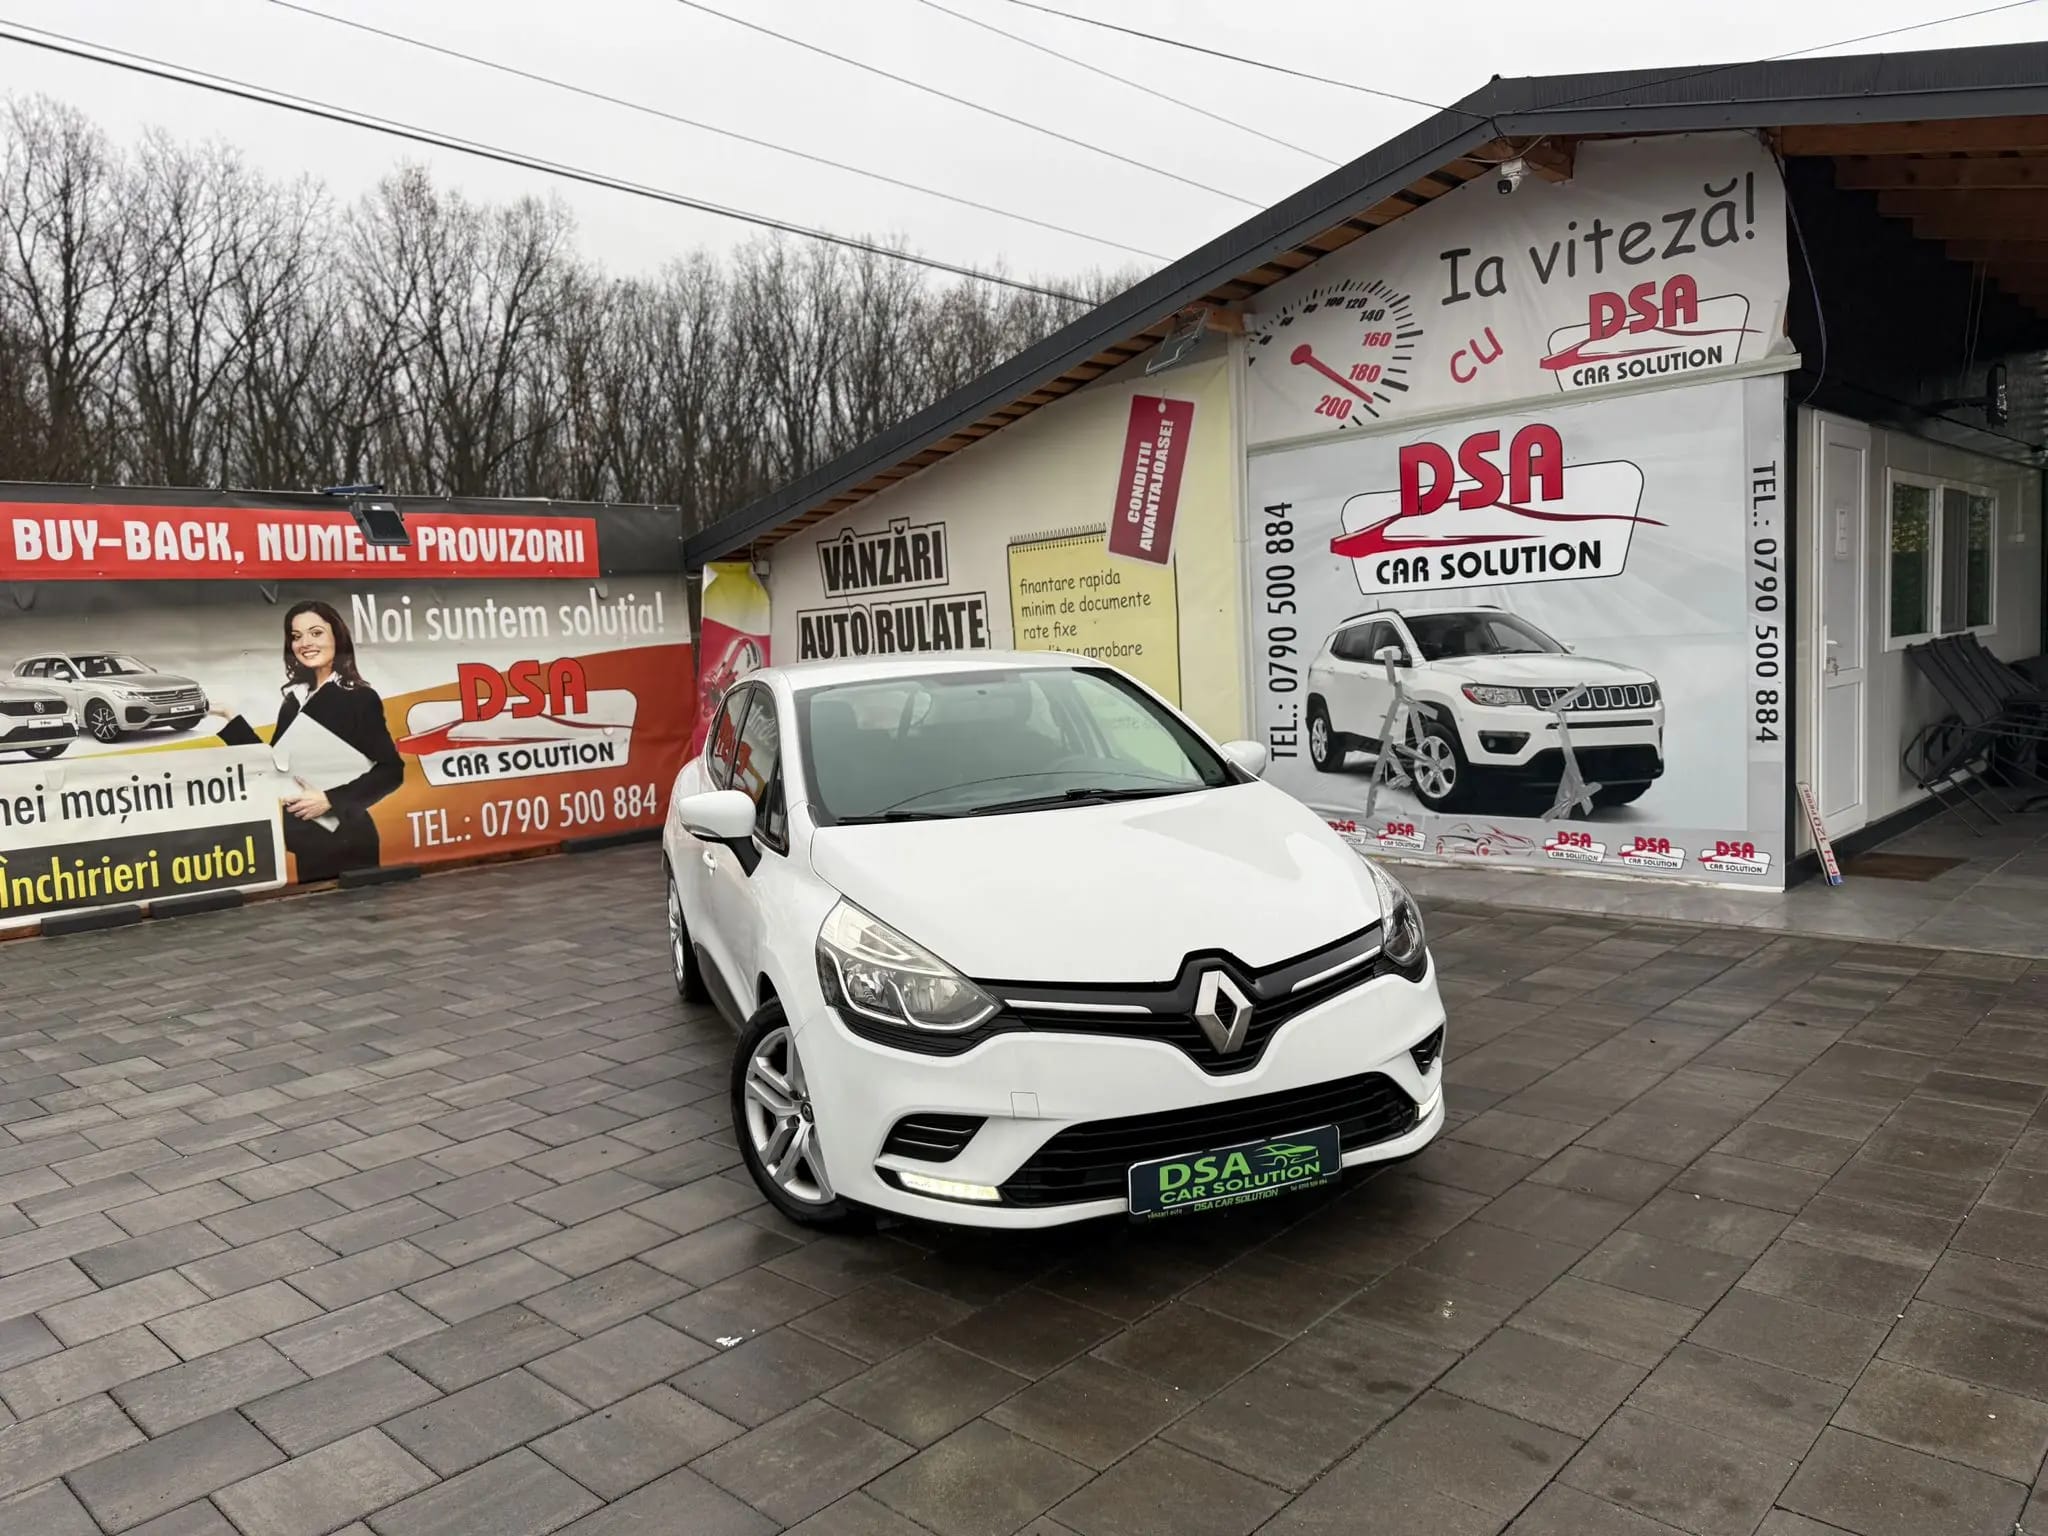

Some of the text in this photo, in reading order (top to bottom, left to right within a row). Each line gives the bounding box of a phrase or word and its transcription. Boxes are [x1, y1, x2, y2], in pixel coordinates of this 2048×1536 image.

[1440, 171, 1755, 305] Ia viteză!
[1345, 297, 1368, 309] 120
[1360, 309, 1386, 321] 140
[1588, 274, 1698, 341] DSA
[1362, 332, 1392, 347] 160
[1450, 326, 1503, 383] cu
[1349, 363, 1382, 383] 180
[1573, 345, 1723, 387] CAR SOLUTION
[1314, 394, 1353, 420] 200
[1127, 441, 1152, 523] CONDITII
[1139, 419, 1174, 552] AVANTAJOASE!
[1399, 423, 1563, 517] DSA
[12, 519, 244, 564] BUY-BACK,
[417, 526, 585, 563] PROVIZORII
[822, 526, 944, 591] VÂNZĂRI
[1020, 568, 1121, 596] finantare rapida
[1376, 540, 1601, 585] CAR SOLUTION
[352, 594, 414, 644] Noi
[425, 598, 549, 642] suntem
[1021, 592, 1151, 618] minim de documente
[1753, 460, 1778, 743] TEL.: 0790 500 884
[1023, 622, 1077, 640] rate fixe
[1083, 640, 1143, 659] aprobare
[1264, 502, 1298, 761] TEL.: 0790 500 884
[457, 657, 588, 722] DSA
[442, 742, 615, 777] CAR SOLUTION
[60, 771, 174, 824] mașini
[187, 763, 248, 807] noi!
[406, 783, 657, 848] TEL.: 0790 500 884
[1387, 822, 1414, 836] DSA
[1557, 831, 1591, 848] DSA
[1565, 852, 1598, 861] SOLUTION
[1634, 836, 1670, 853] DSA
[1715, 841, 1755, 858] DSA
[172, 836, 256, 884] auto!
[1643, 859, 1678, 868] SOLUTION
[1725, 864, 1763, 873] SOLUTION
[1159, 1151, 1252, 1191] DSA
[1160, 1184, 1206, 1204] CAR
[1213, 1161, 1320, 1193] SOLUTION
[1193, 1188, 1279, 1212] DSA CAR SOLUTION
